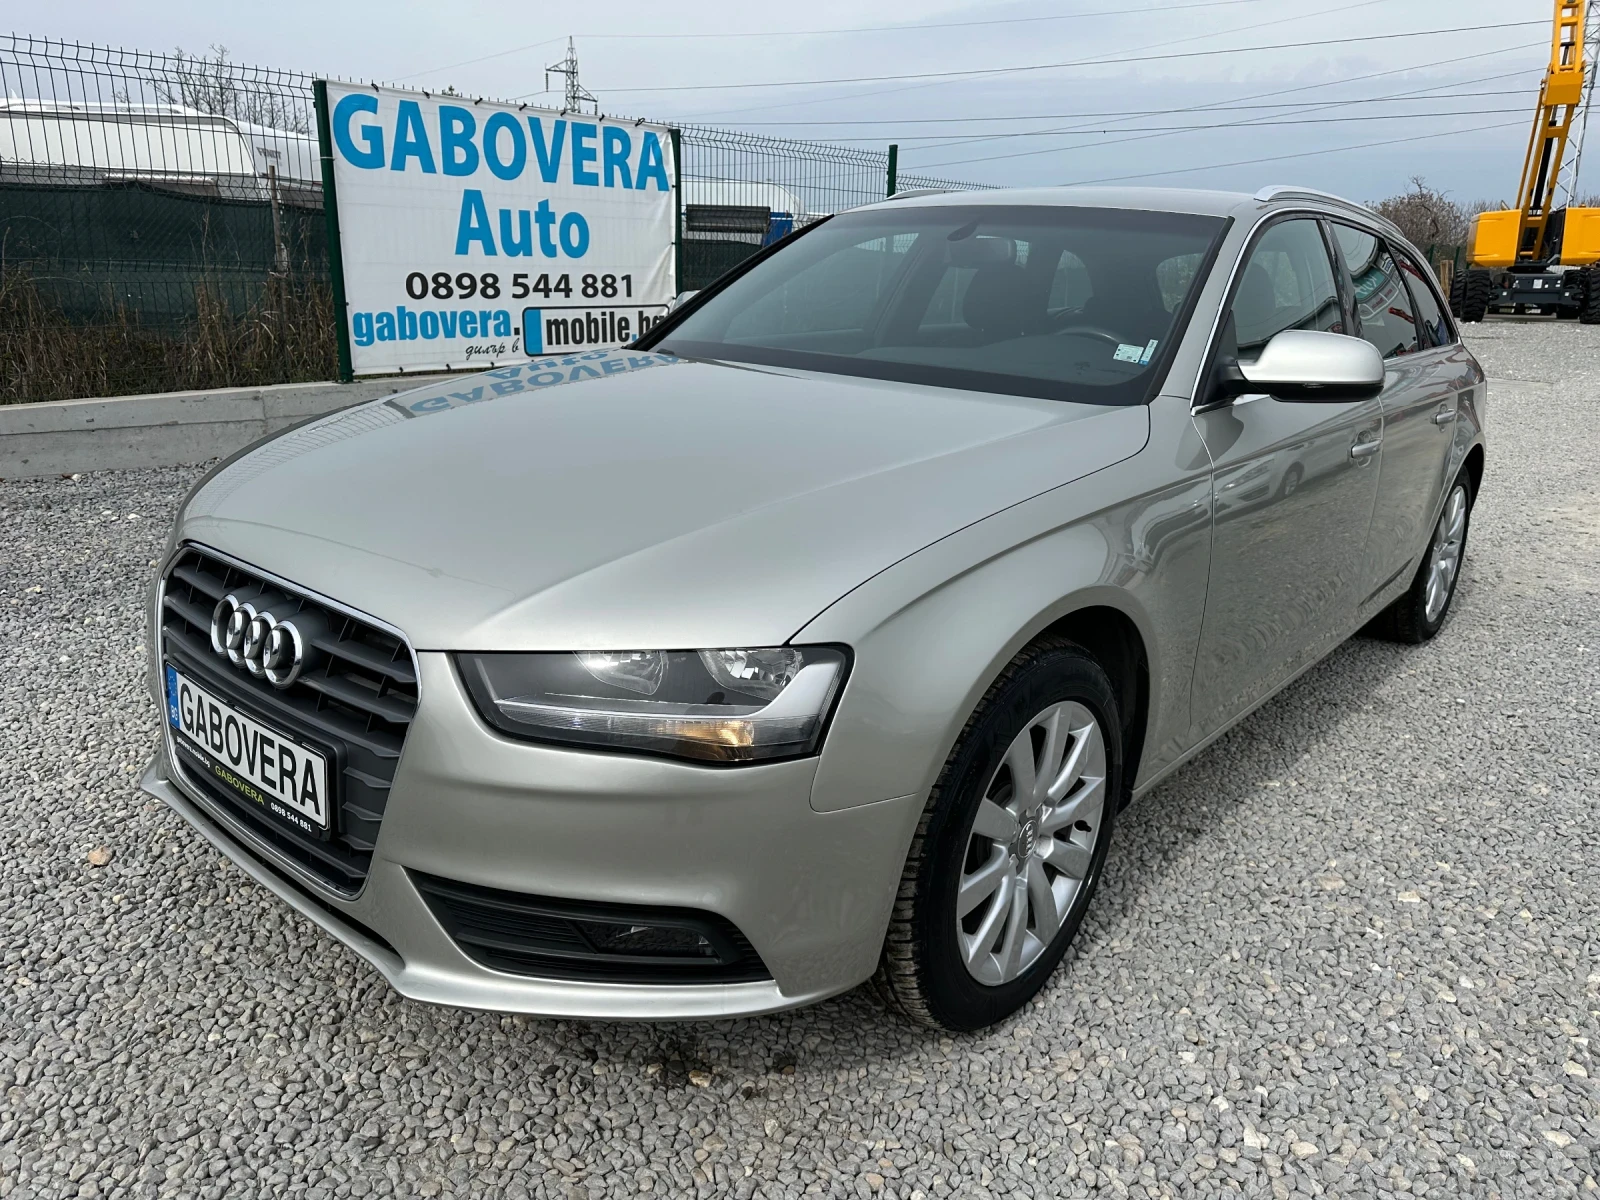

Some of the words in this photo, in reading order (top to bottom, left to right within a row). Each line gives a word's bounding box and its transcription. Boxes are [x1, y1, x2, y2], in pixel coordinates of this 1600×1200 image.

[333, 94, 669, 191] GABOVERA
[455, 188, 590, 258] Auto
[406, 272, 500, 299] 0898
[512, 274, 572, 298] 544
[582, 274, 632, 298] 881
[171, 704, 179, 721] BG
[180, 683, 321, 817] GABOVERA
[214, 765, 265, 805] GABOVERA
[270, 802, 286, 817] 0898
[286, 812, 299, 825] 544
[299, 819, 312, 832] 881
